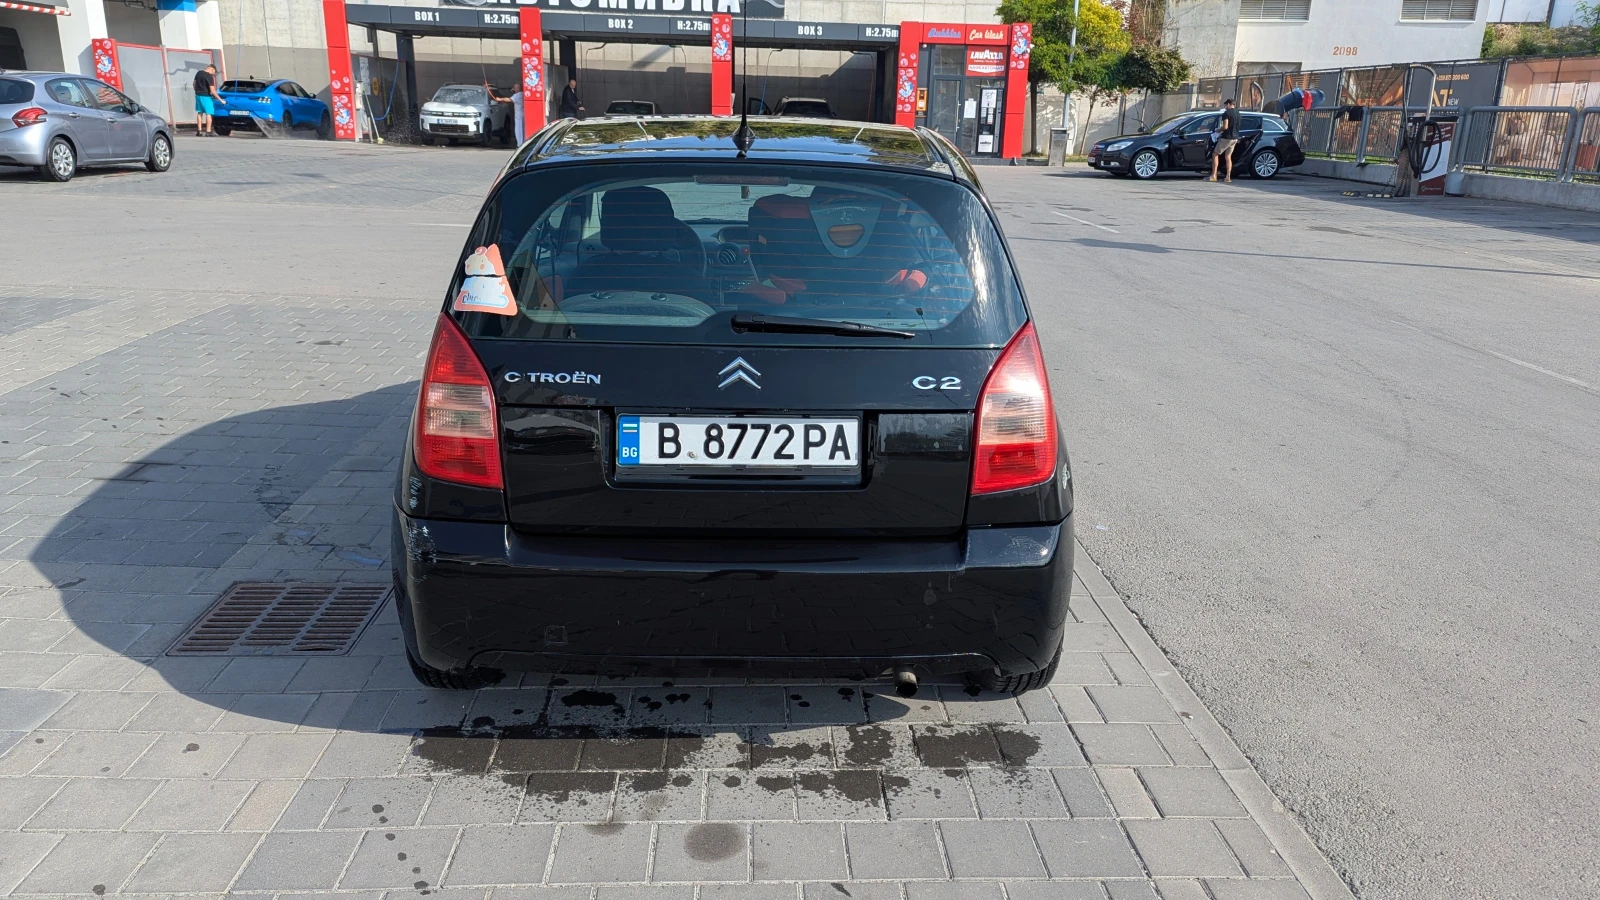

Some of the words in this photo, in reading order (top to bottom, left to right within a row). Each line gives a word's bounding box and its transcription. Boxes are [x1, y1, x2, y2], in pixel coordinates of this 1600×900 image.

[414, 11, 433, 21] BOX
[434, 11, 440, 22] 1
[608, 18, 626, 29] BOX
[627, 19, 634, 29] 2
[797, 25, 815, 35] BOX
[816, 25, 823, 36] 3
[865, 27, 899, 38] H:2.75m
[969, 29, 983, 41] Car
[984, 29, 1004, 40] Wash
[970, 49, 1003, 60] LAVAZZA
[1332, 46, 1358, 56] 2098
[912, 376, 961, 390] C2
[658, 422, 682, 459] B
[622, 447, 638, 458] BG
